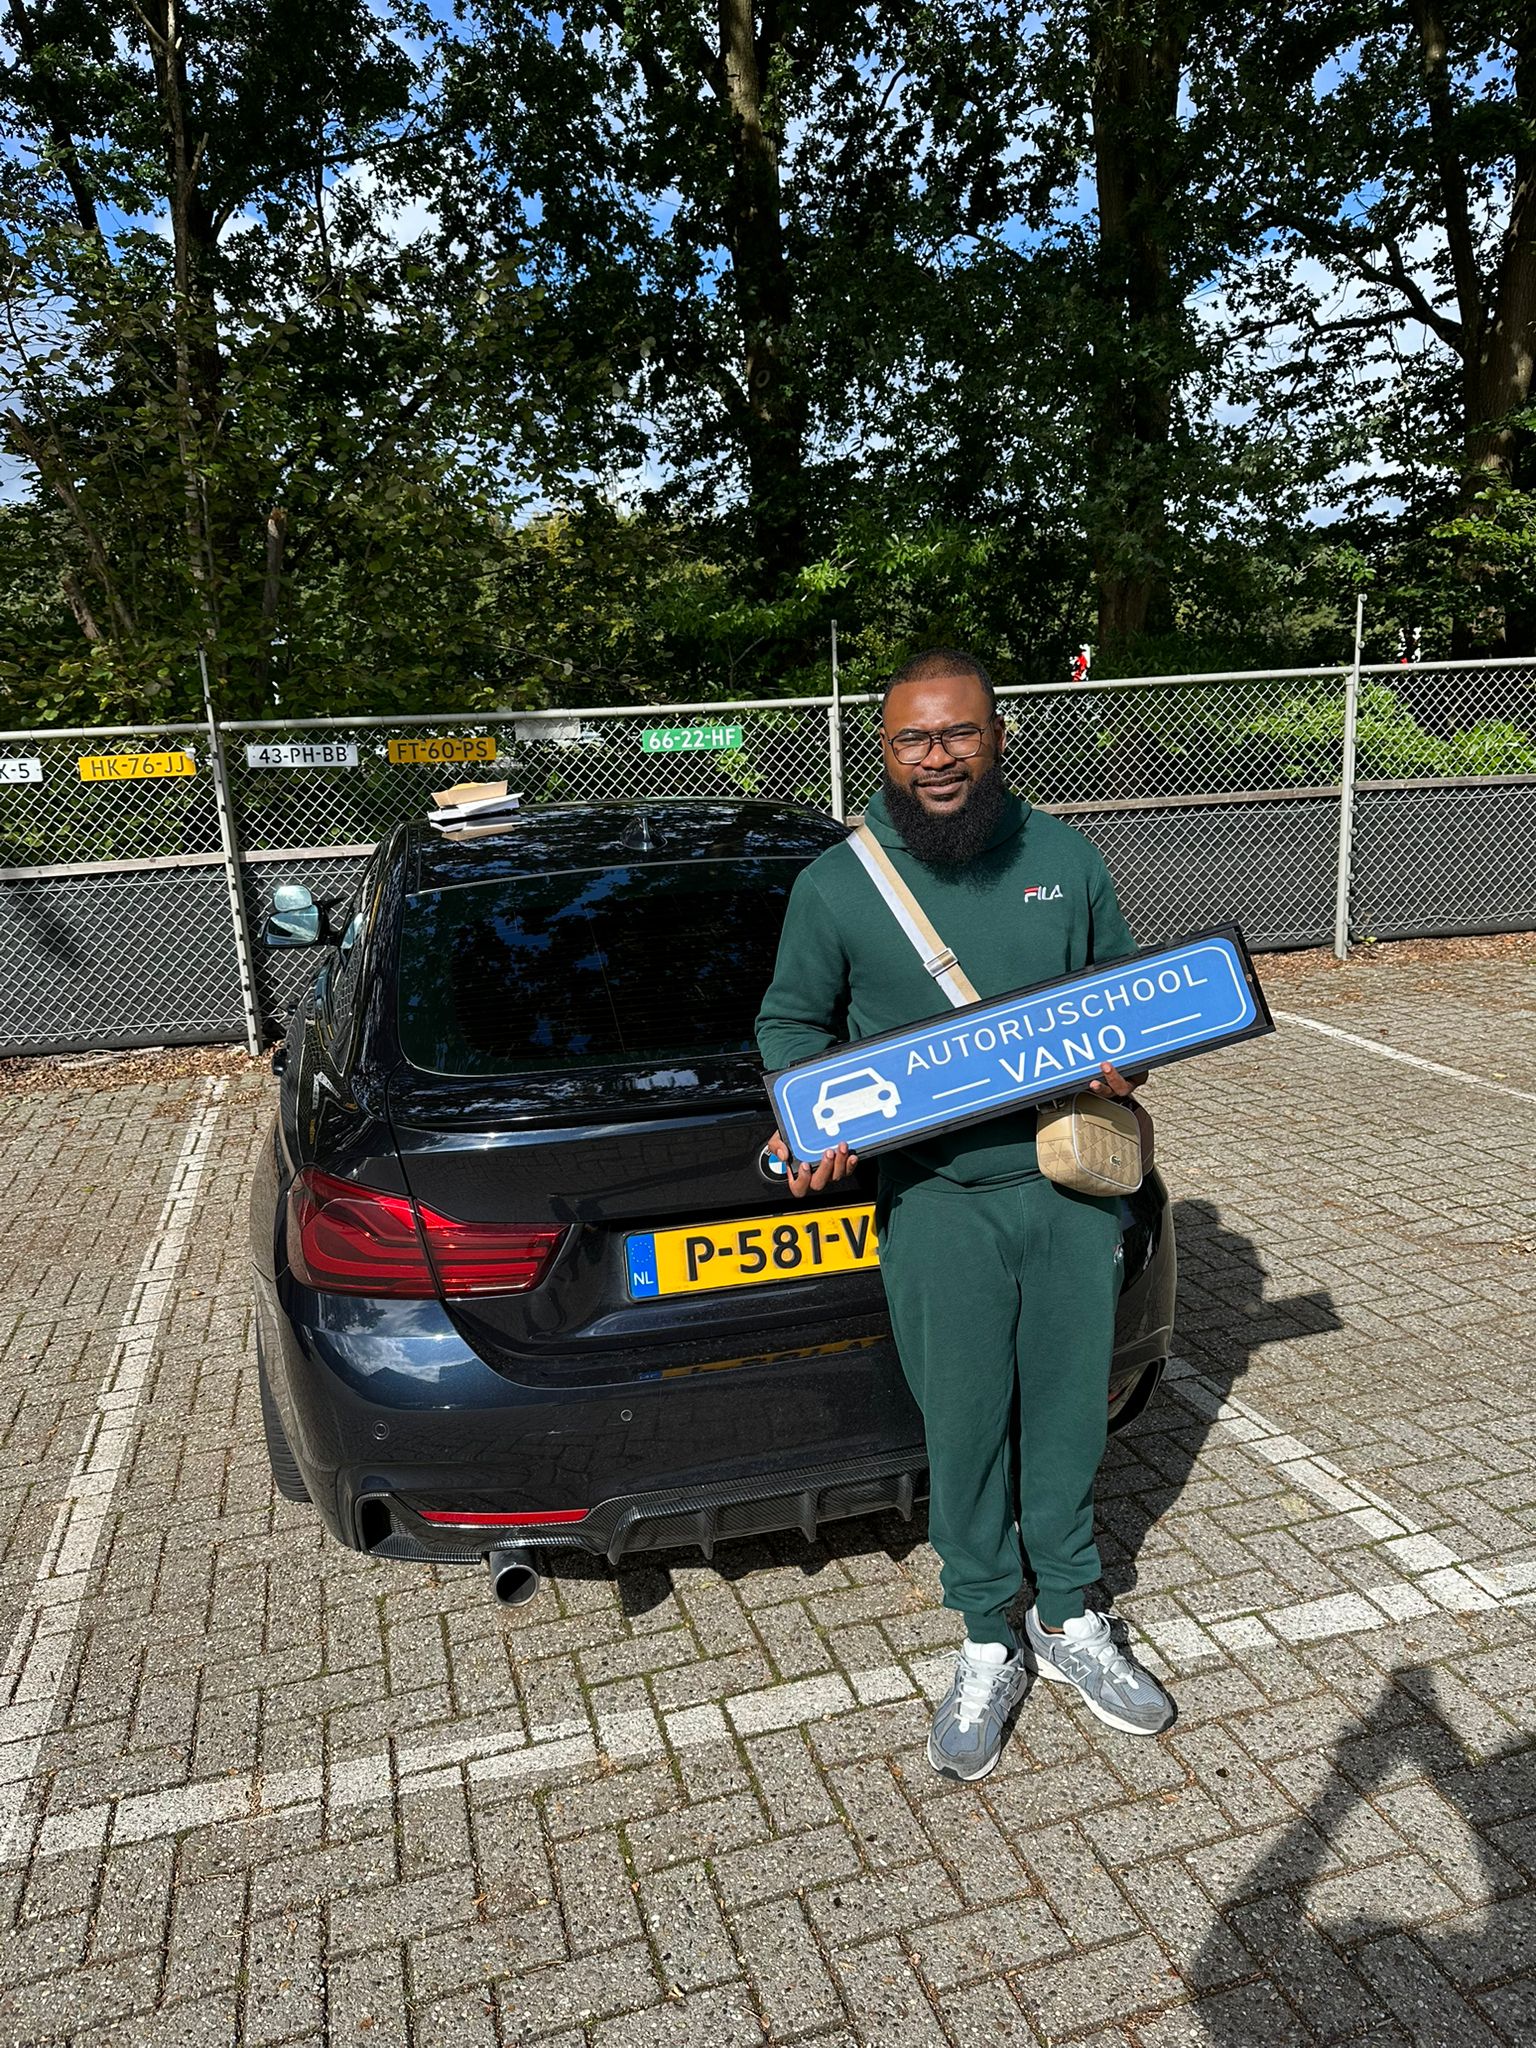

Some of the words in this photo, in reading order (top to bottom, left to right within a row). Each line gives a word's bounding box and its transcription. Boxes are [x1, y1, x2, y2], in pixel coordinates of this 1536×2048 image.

[648, 726, 736, 750] 66-22-HF
[259, 745, 347, 764] 43-PH-BB
[396, 740, 488, 760] FT-60-PS
[91, 755, 186, 777] HK-76-JJ
[1024, 884, 1064, 903] FILA
[906, 964, 1208, 1076] AUTORIJSCHOOL
[999, 1024, 1127, 1084] VANO
[685, 1215, 880, 1282] P-581-V
[633, 1271, 654, 1286] NL
